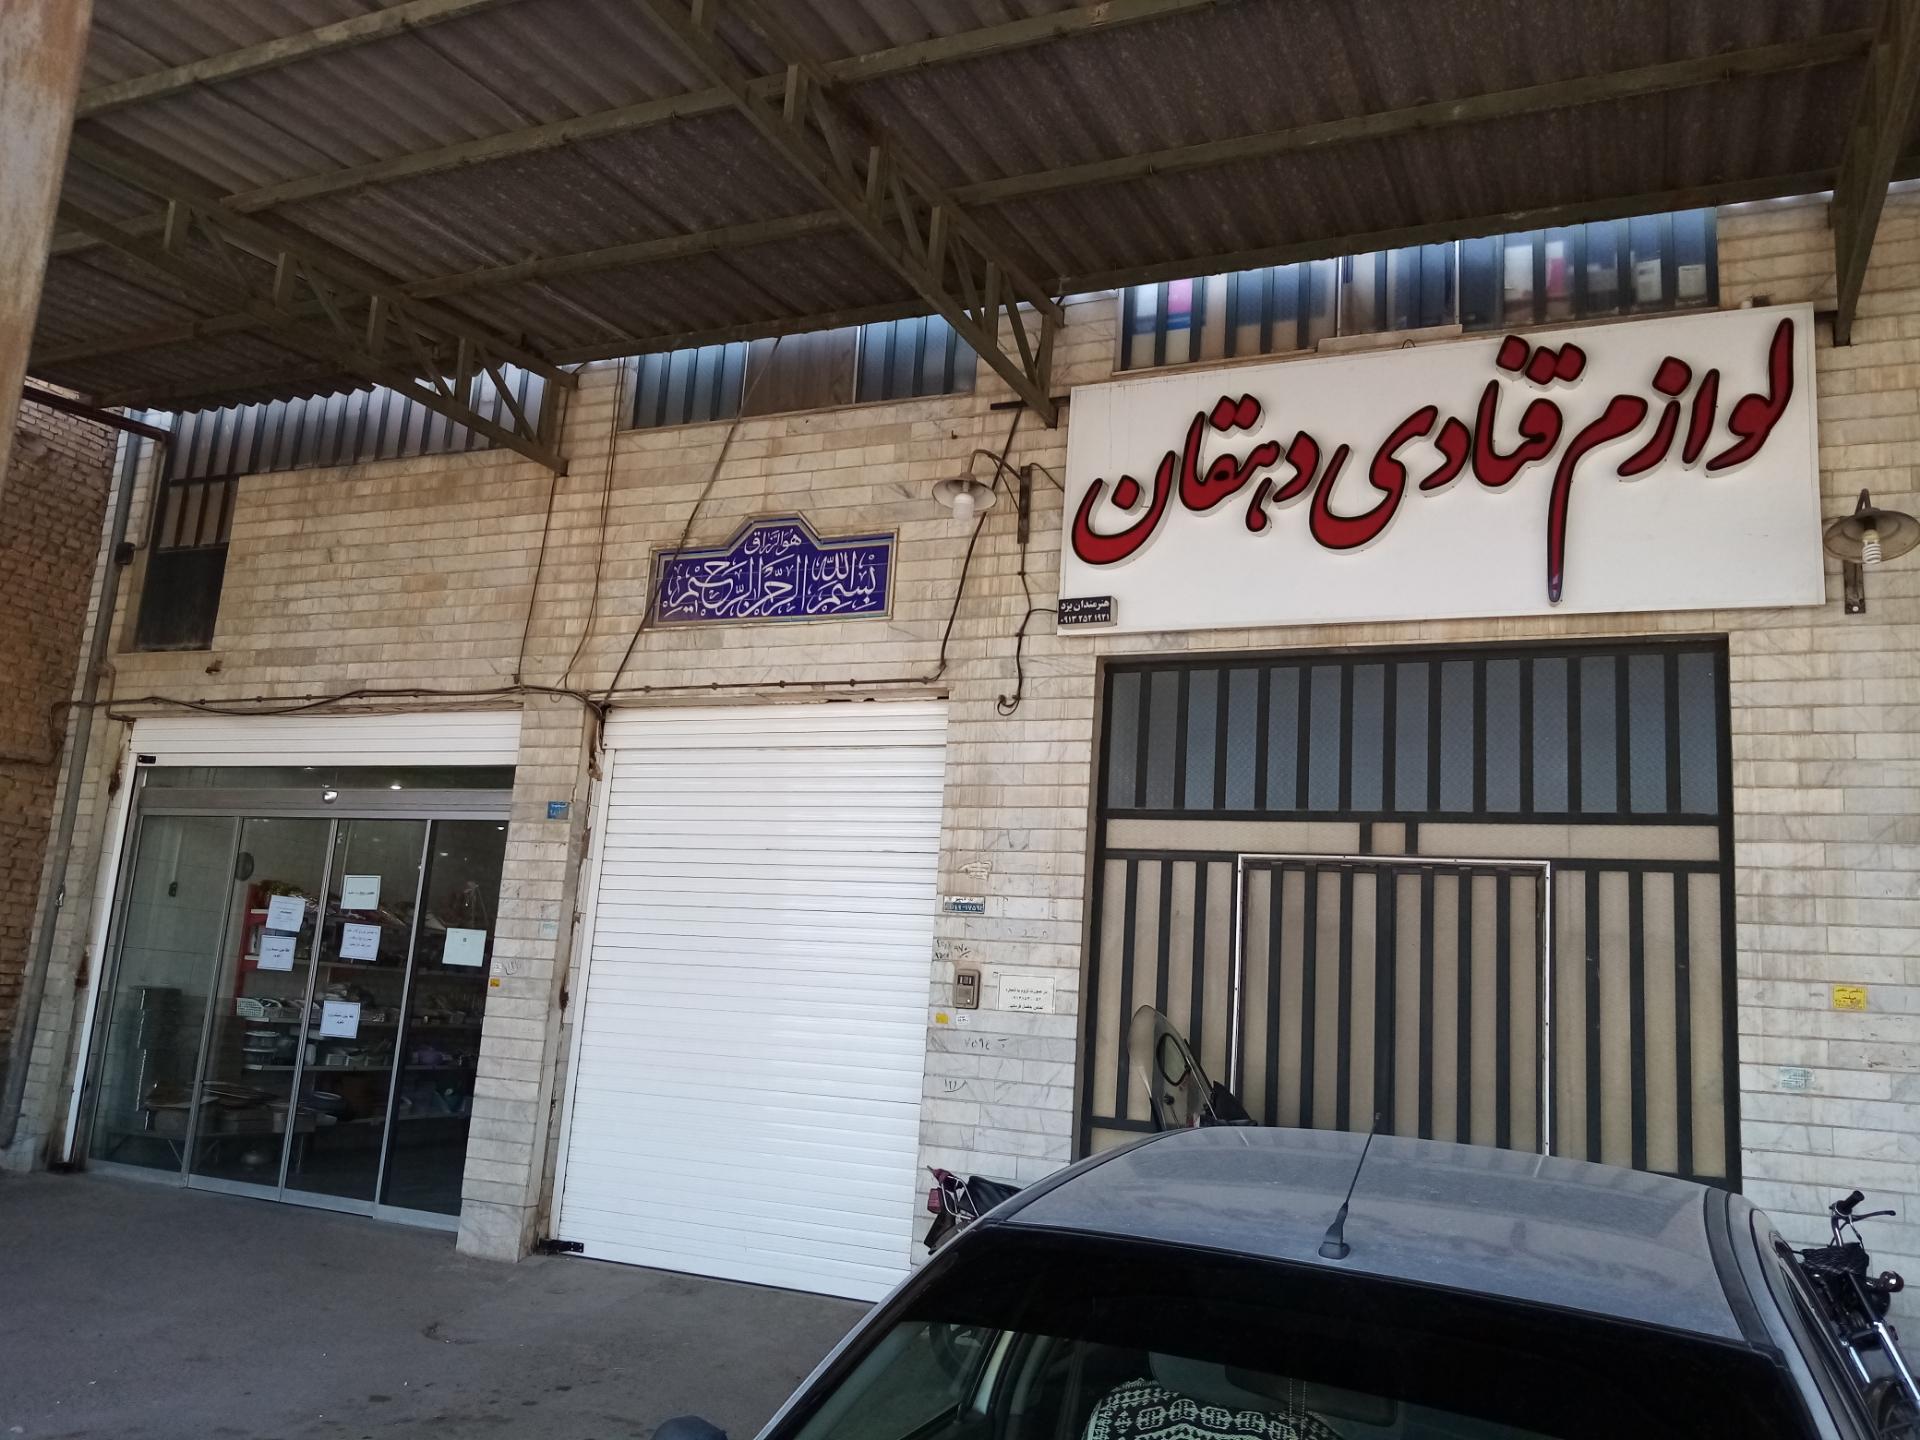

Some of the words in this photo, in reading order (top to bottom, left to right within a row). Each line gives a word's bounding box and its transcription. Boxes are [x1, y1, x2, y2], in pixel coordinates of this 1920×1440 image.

[1070, 393, 1320, 566] دهقان
[1308, 333, 1588, 549] قنادی
[1547, 315, 1795, 605] لوازم
[1060, 602, 1073, 613] یزد
[1072, 599, 1110, 612] هنرمندان
